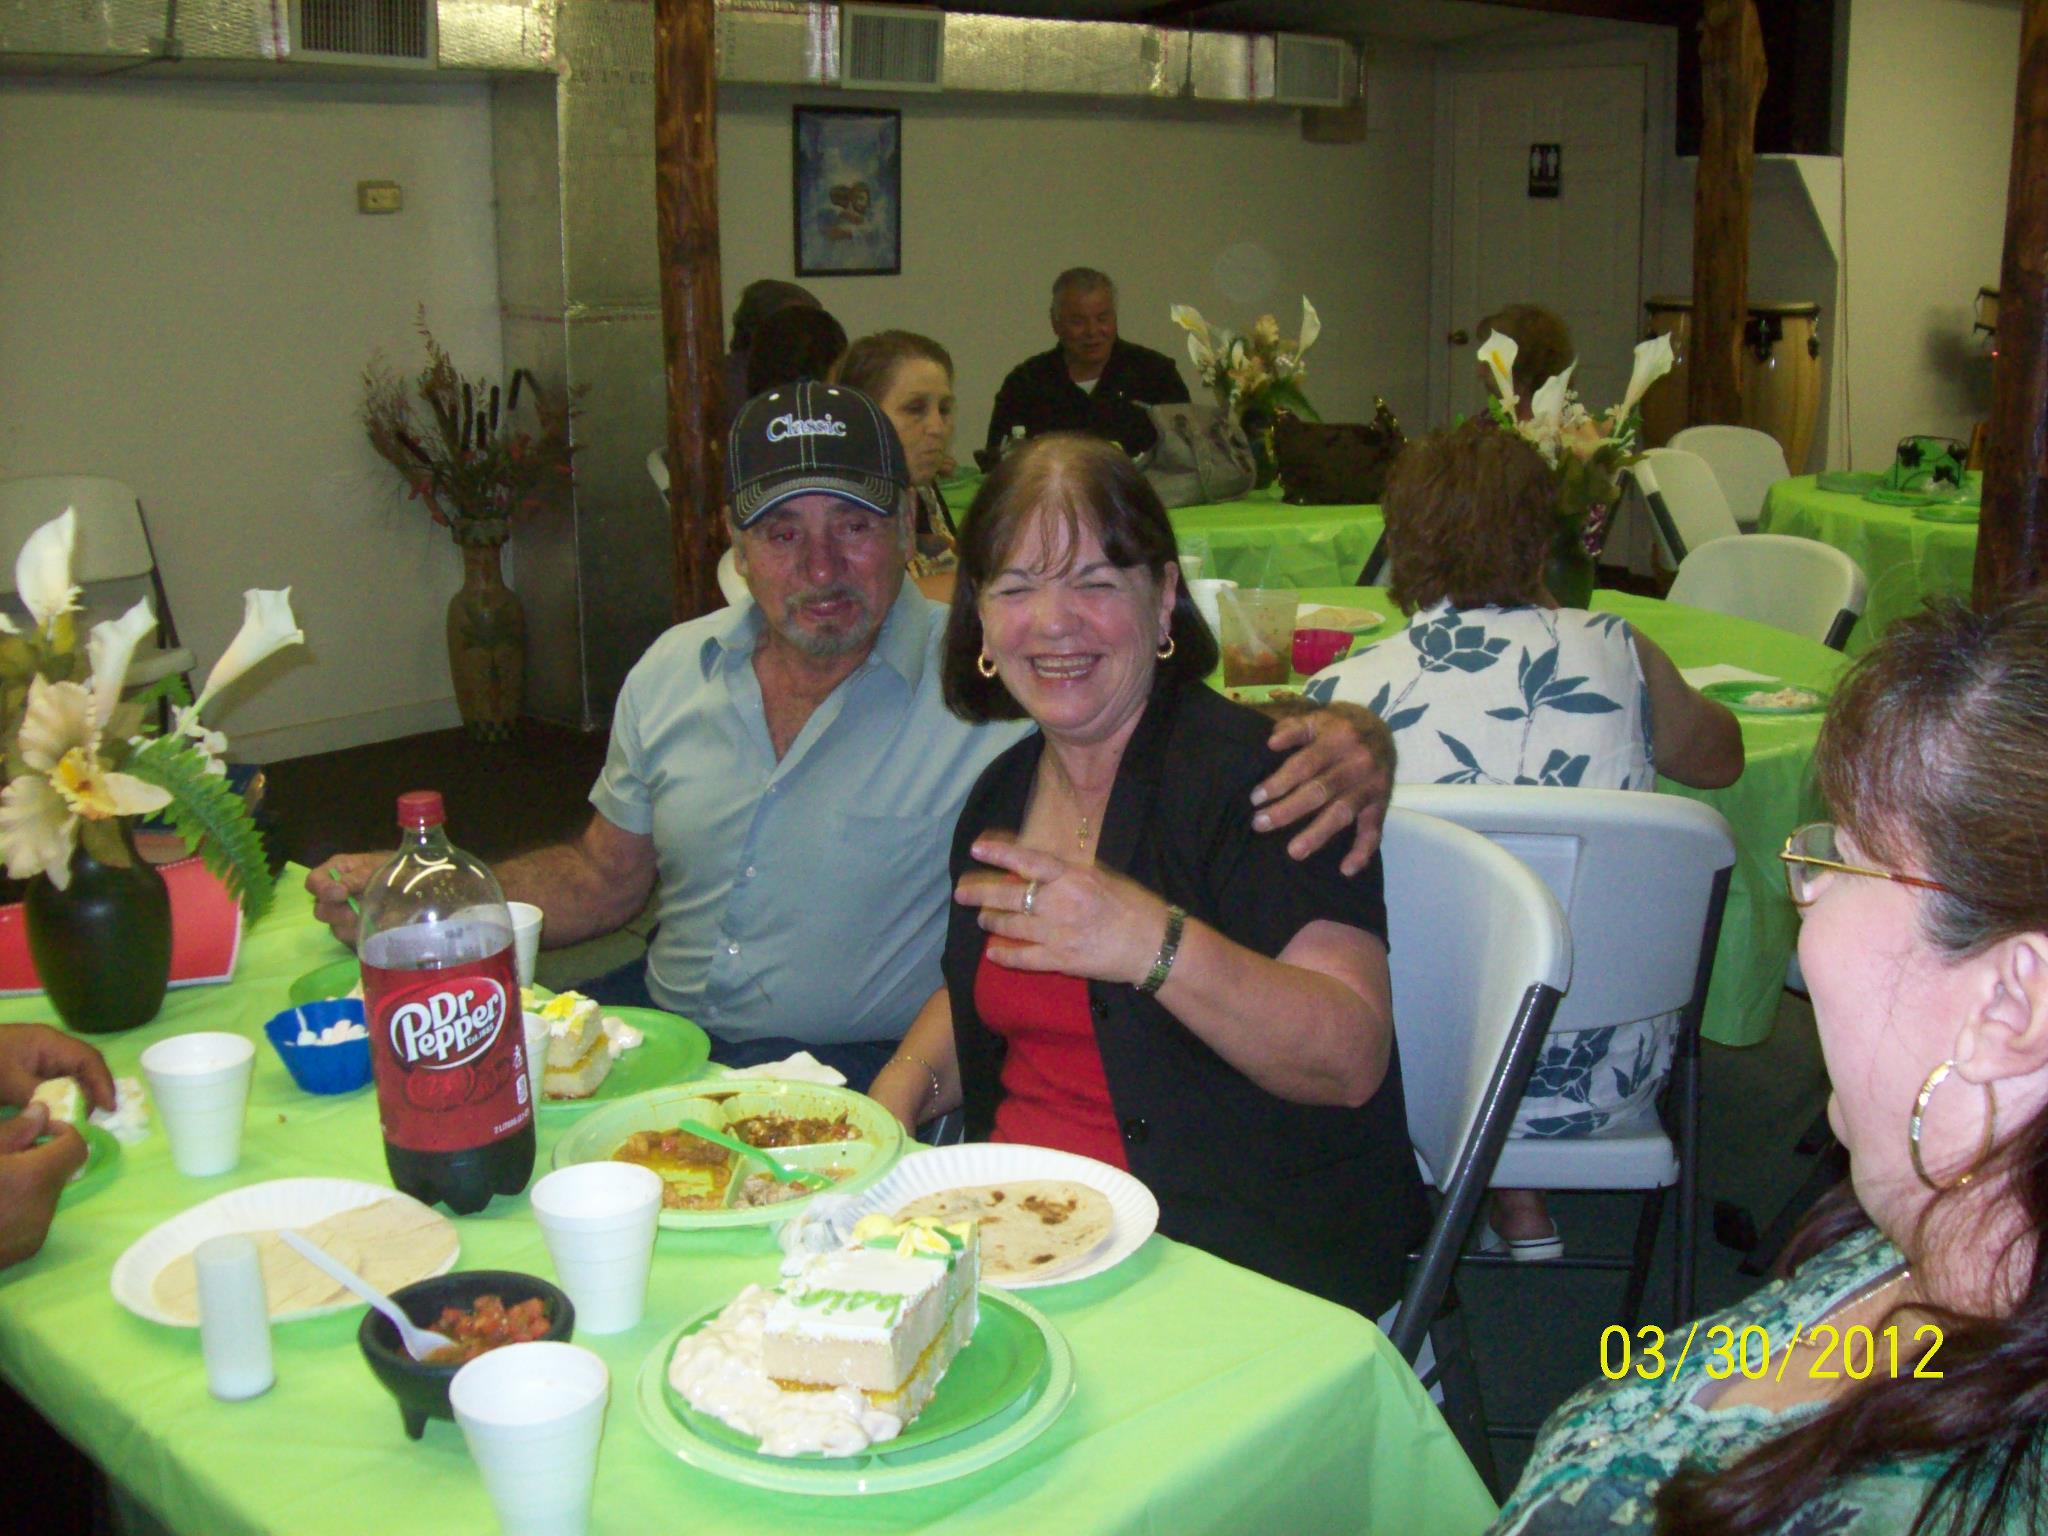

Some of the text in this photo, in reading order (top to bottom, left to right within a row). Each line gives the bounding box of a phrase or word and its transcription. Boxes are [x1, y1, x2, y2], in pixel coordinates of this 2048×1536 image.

[766, 413, 847, 442] Classic
[390, 993, 499, 1061] Pepper
[428, 990, 475, 1029] Dr
